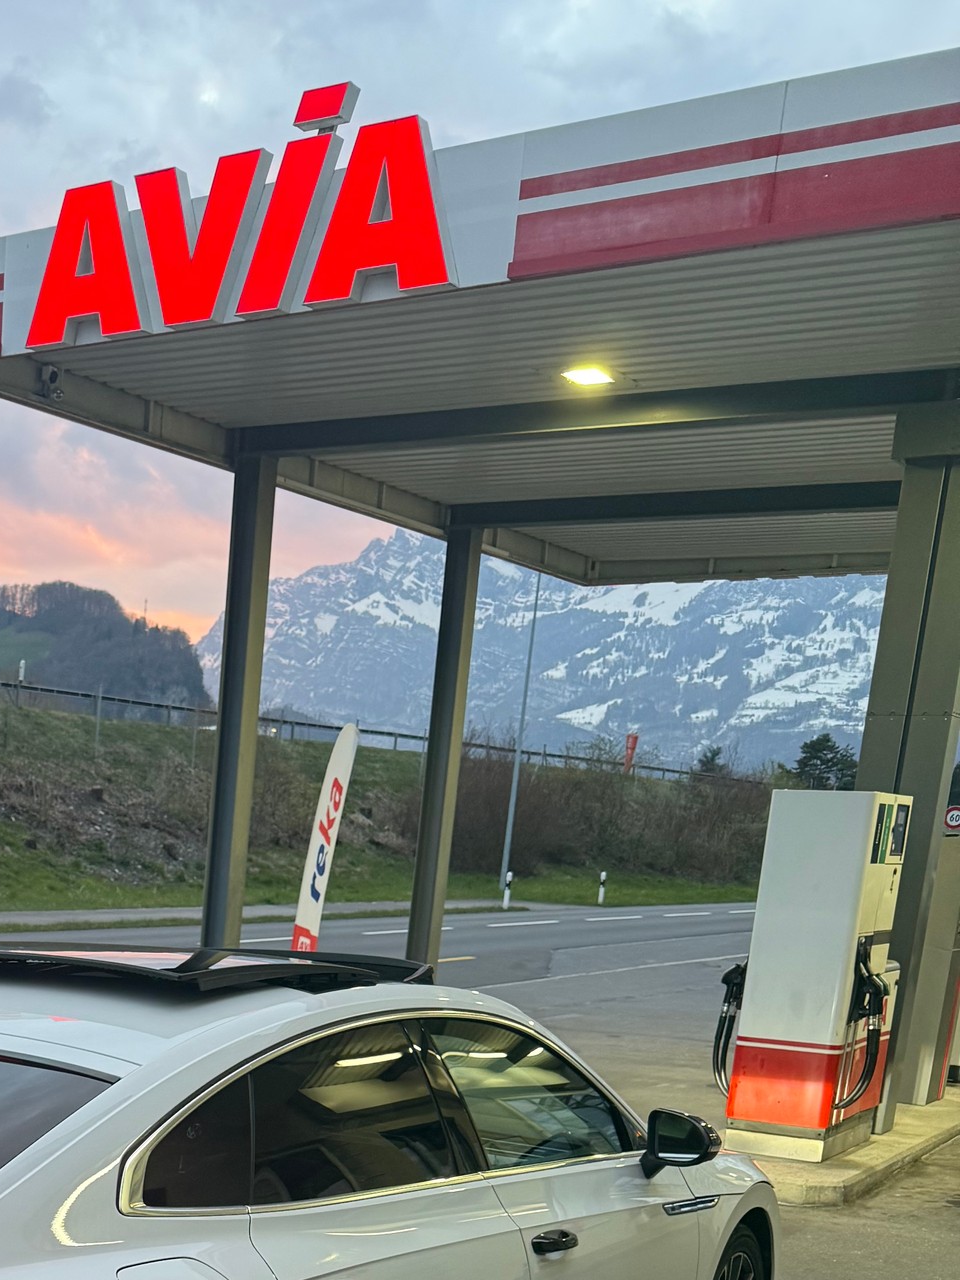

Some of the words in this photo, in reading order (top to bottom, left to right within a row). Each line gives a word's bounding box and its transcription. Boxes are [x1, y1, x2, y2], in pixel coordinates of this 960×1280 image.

[25, 81, 452, 348] AVIA
[310, 777, 343, 903] reka
[949, 814, 960, 823] 60
